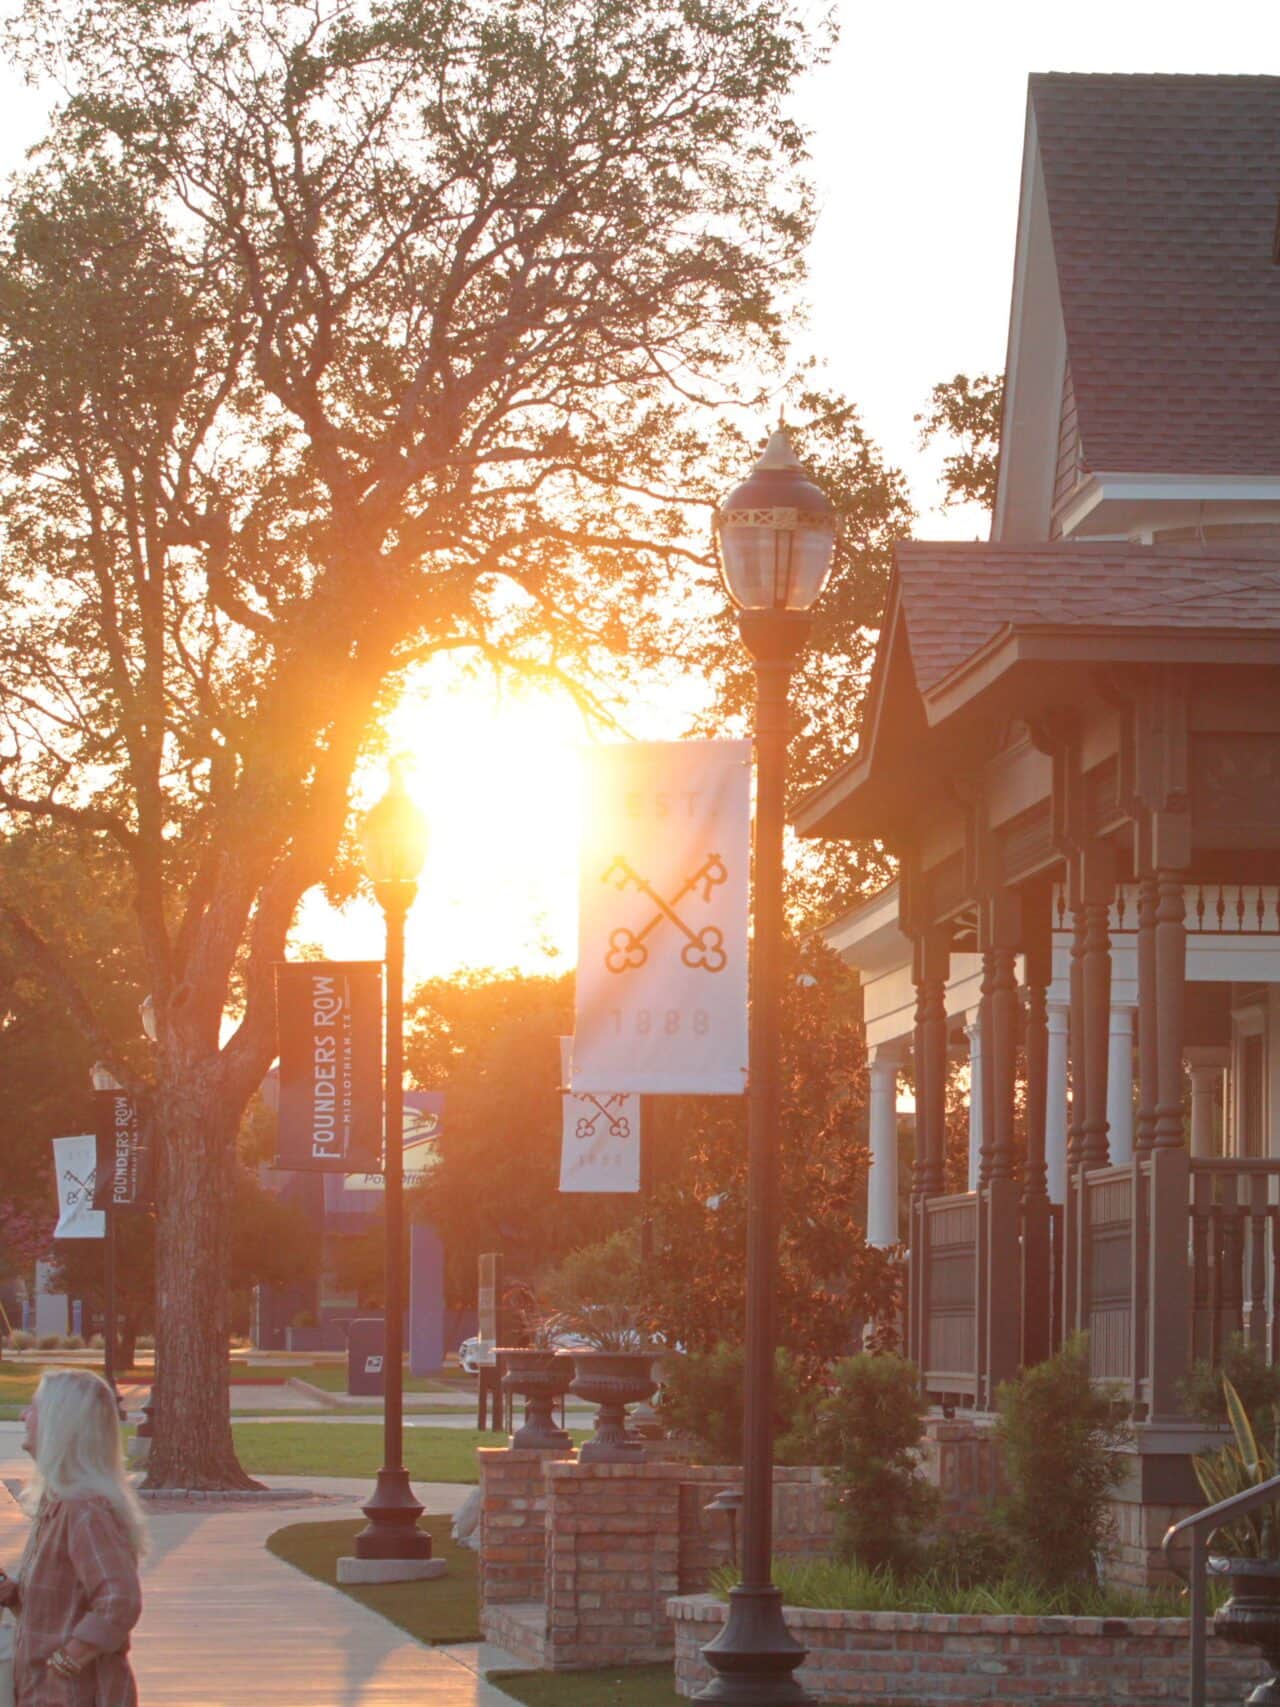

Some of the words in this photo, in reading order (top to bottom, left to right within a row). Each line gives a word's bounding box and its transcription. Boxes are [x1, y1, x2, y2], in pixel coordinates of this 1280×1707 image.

[312, 976, 343, 1027] ROW
[114, 1096, 132, 1126] ROW
[312, 1036, 341, 1158] FOUNDERS
[113, 1131, 130, 1204] FOUNDERS
